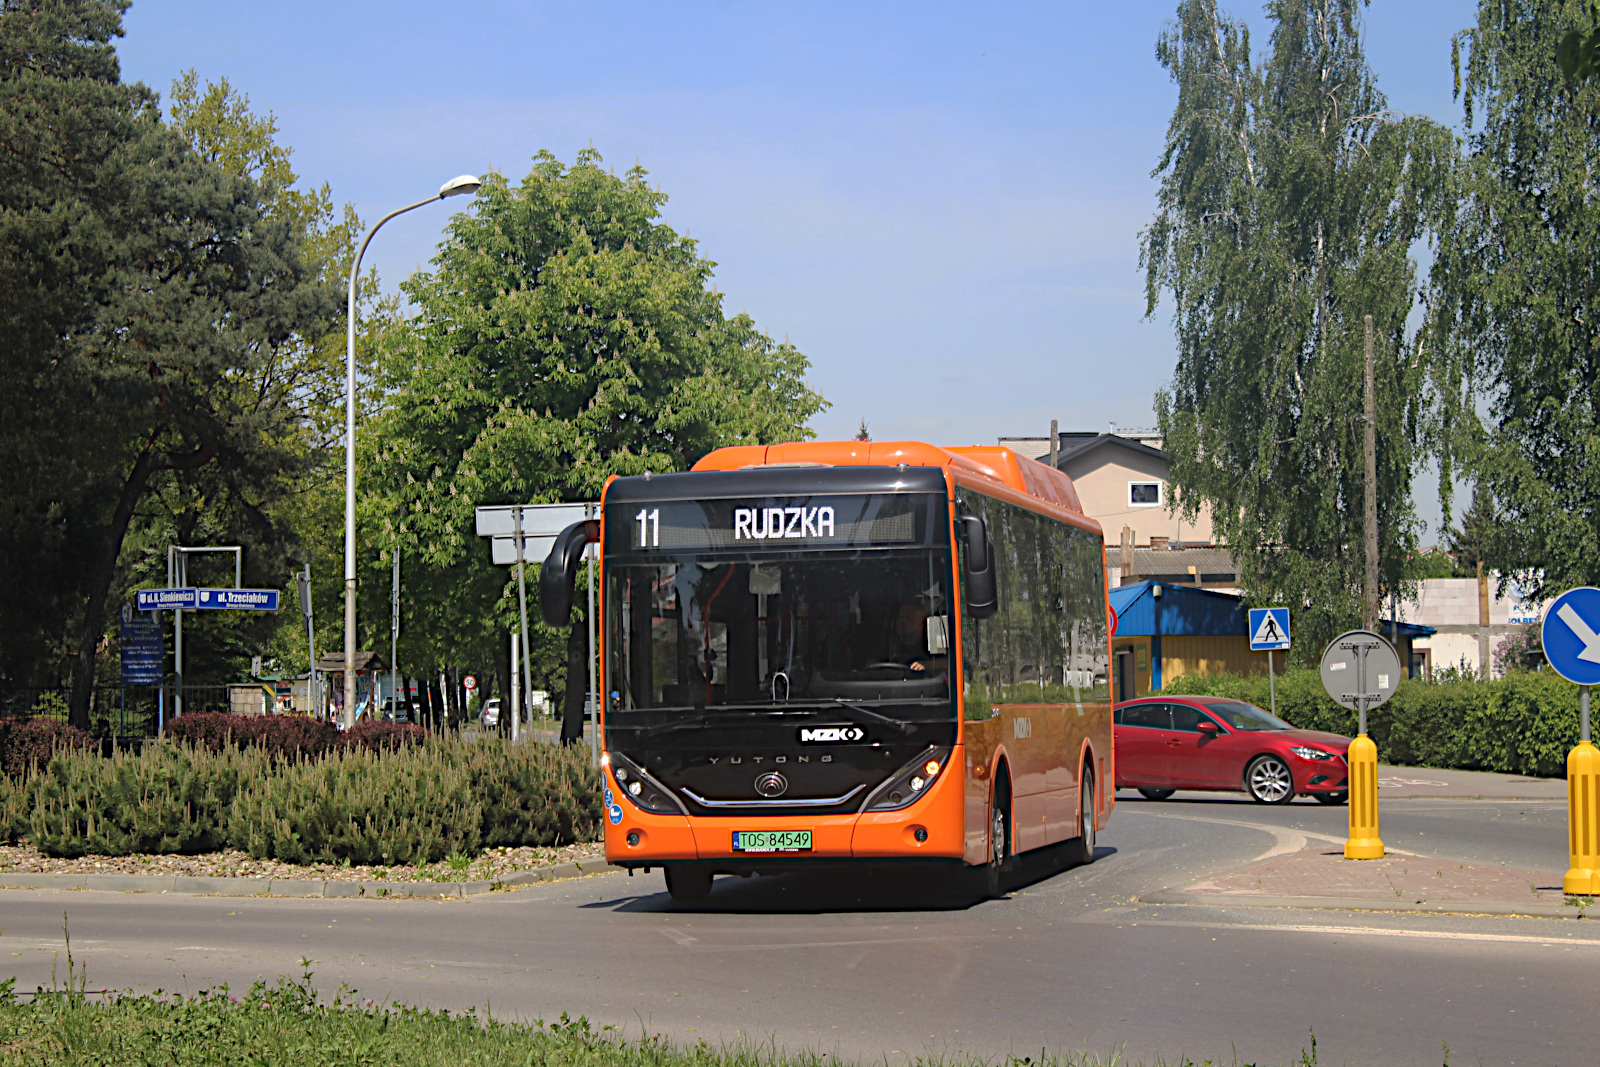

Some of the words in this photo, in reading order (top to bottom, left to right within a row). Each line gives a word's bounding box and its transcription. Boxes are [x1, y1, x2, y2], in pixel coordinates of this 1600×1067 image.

[635, 508, 659, 547] 11
[734, 506, 835, 540] RUDZKA
[160, 591, 194, 603] Sienkiewicza
[217, 592, 227, 603] ul.
[228, 592, 268, 604] Trzeciaków
[466, 678, 474, 686] 50
[801, 728, 849, 741] MZK
[709, 755, 832, 764] YUTONG
[740, 833, 764, 847] TOS
[769, 832, 809, 846] 84549
